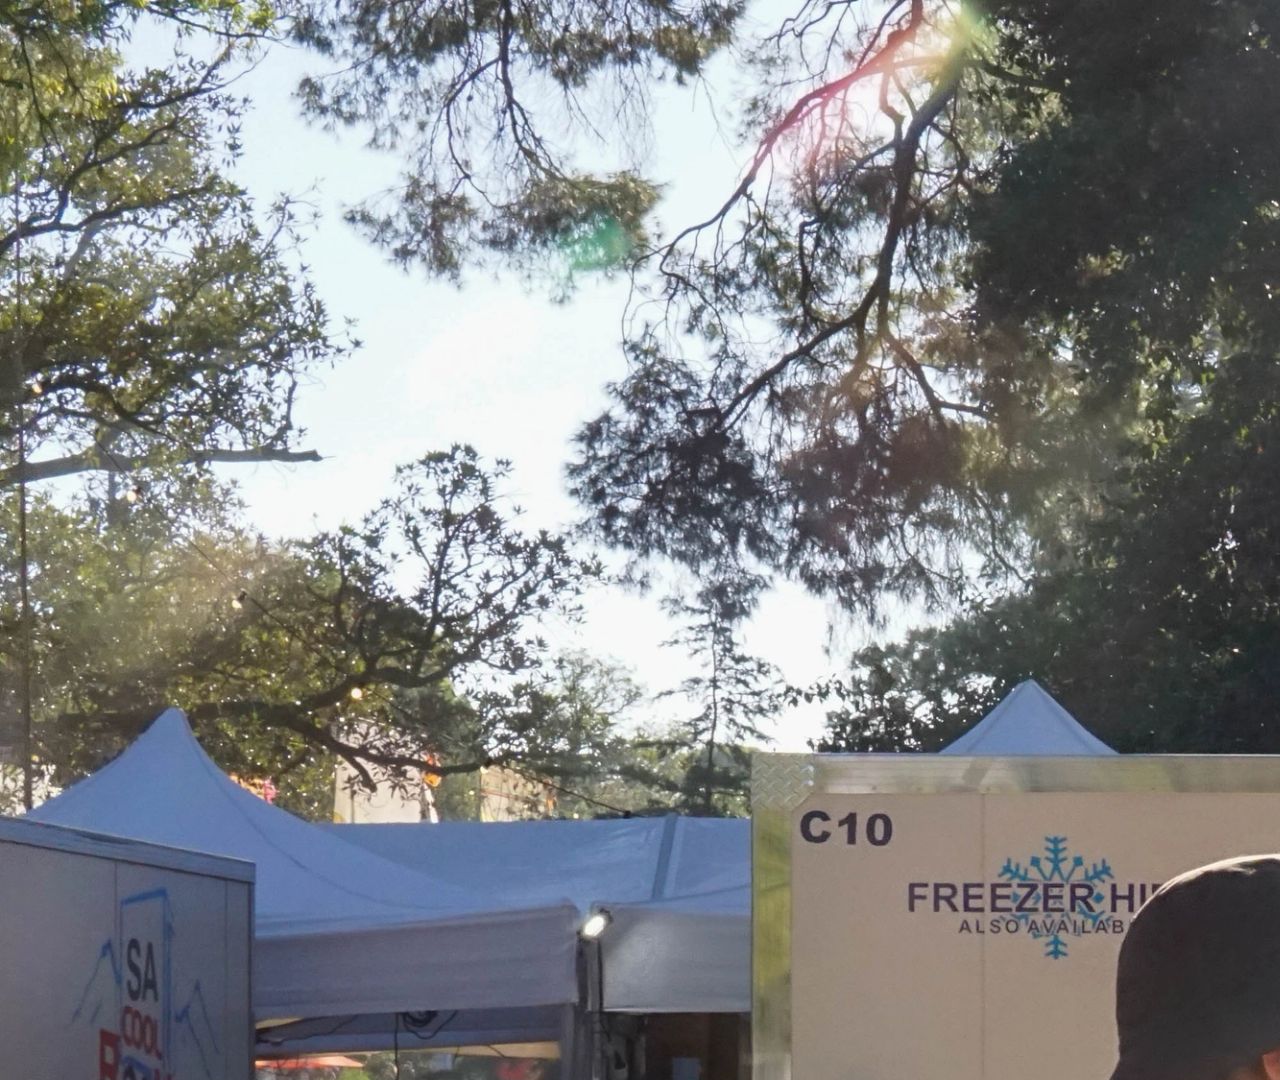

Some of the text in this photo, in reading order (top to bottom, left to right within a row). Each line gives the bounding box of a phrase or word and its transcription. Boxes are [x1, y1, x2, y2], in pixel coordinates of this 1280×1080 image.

[799, 809, 893, 847] C10
[907, 881, 1163, 913] FREEZER HI
[958, 918, 1126, 935] ALSO AVAILAB
[126, 937, 159, 1001] SA
[121, 1004, 163, 1061] COOL
